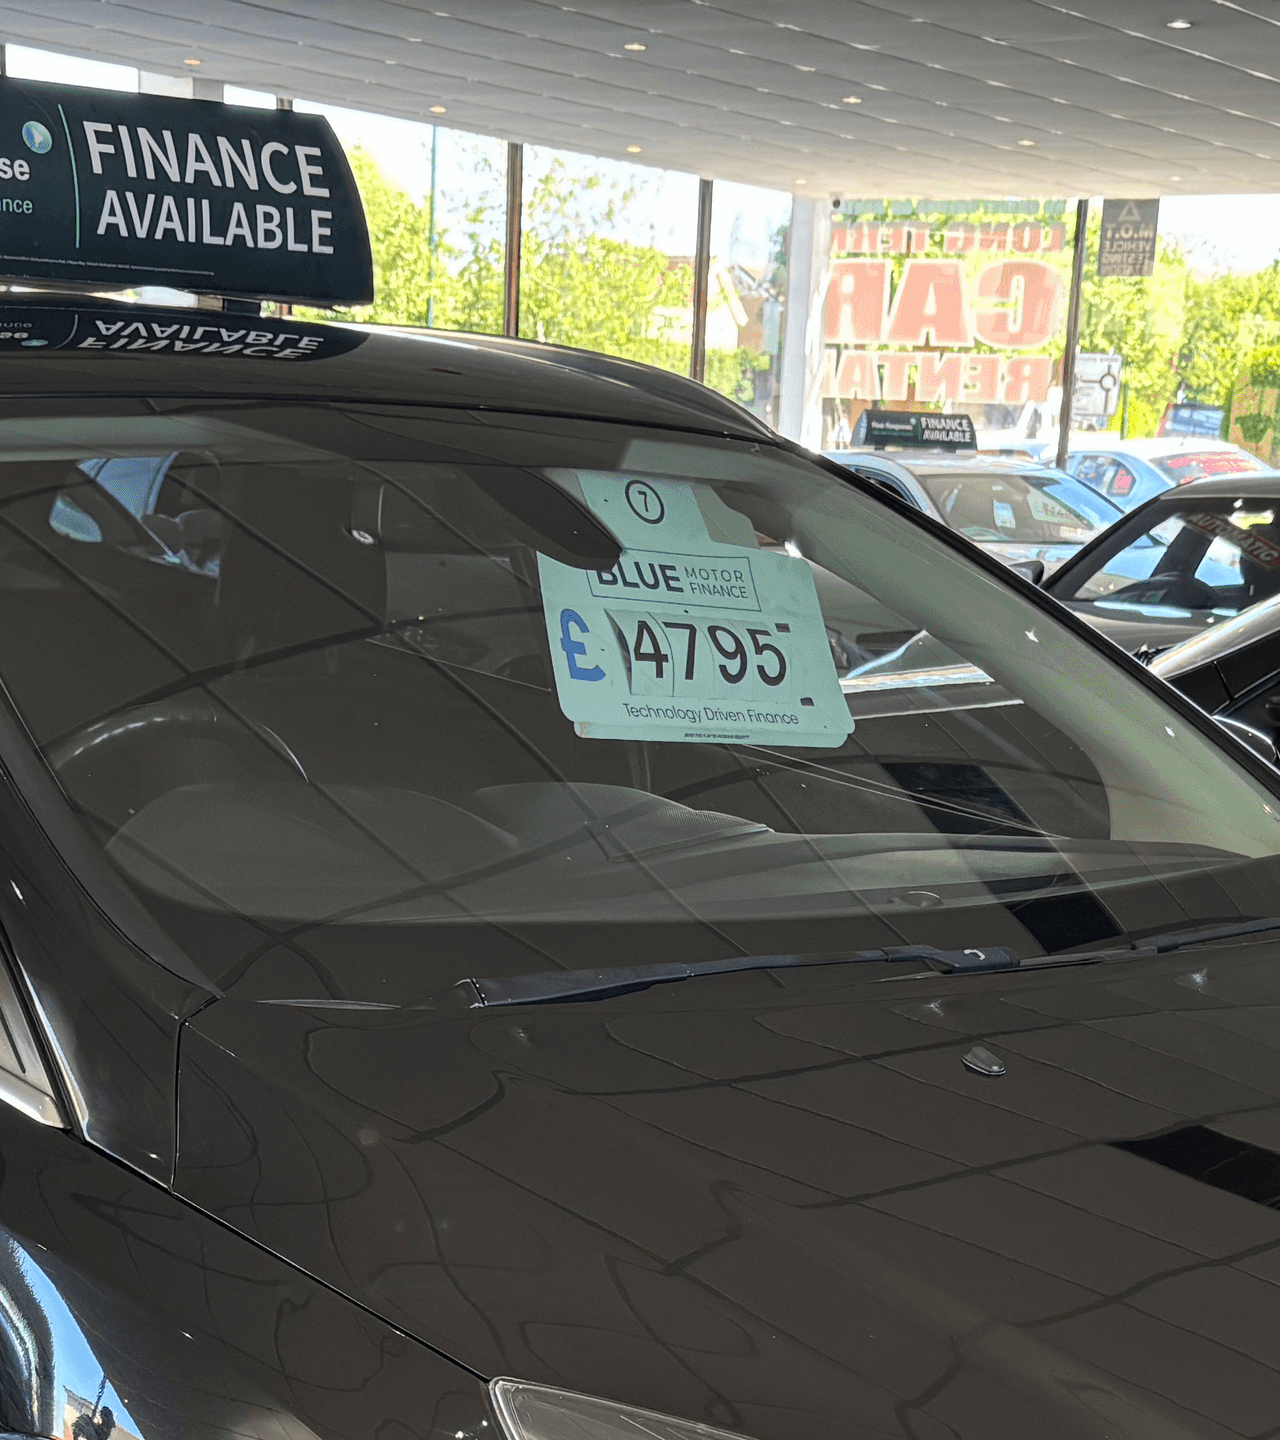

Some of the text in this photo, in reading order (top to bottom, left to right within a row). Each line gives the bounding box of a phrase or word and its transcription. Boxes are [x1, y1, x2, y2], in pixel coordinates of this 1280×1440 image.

[83, 121, 331, 198] FINANCE
[97, 189, 334, 255] AVAILABLE
[684, 566, 744, 583] MOTOR
[690, 581, 749, 600] FINANCE
[634, 620, 787, 687] 4795
[623, 703, 799, 725] Technology Driven Finance
